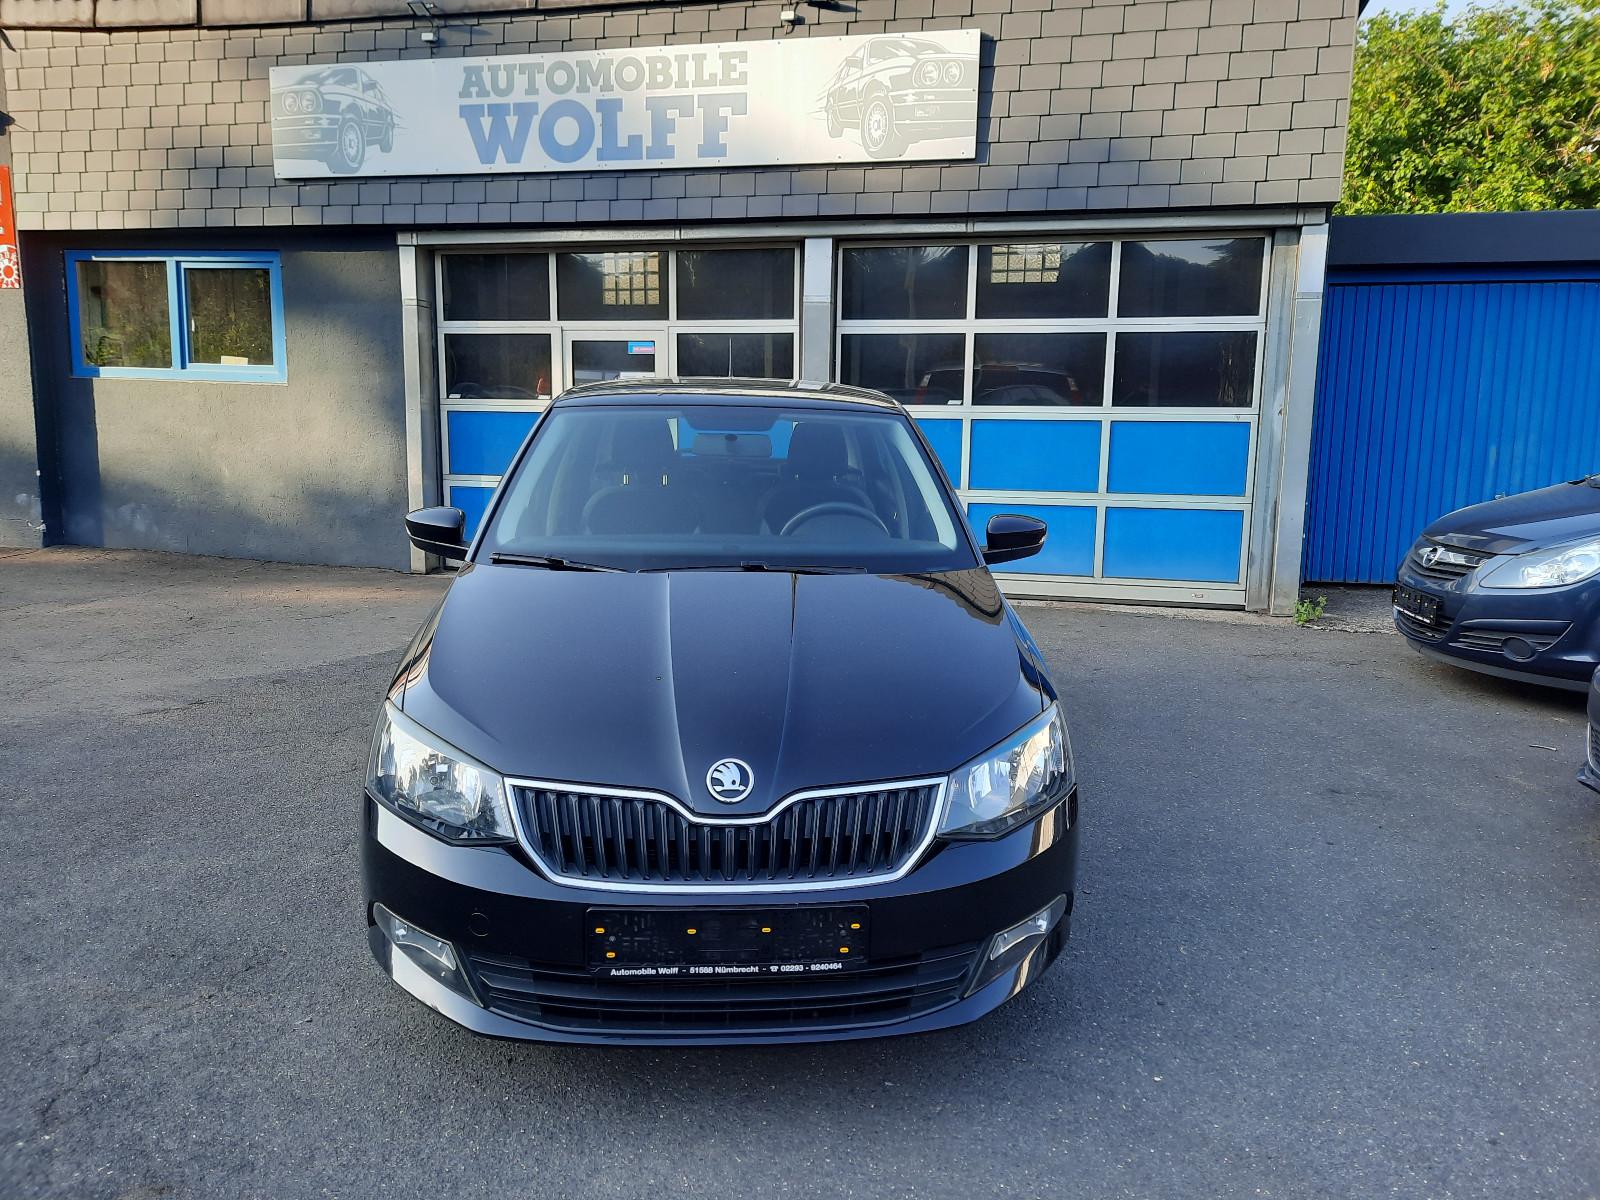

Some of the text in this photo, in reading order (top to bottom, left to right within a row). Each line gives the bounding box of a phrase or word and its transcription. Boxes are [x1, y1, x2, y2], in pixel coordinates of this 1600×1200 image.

[458, 50, 749, 98] AUTOMOBILE
[458, 92, 748, 165] WOLFF
[610, 967, 657, 976] Automobile
[657, 967, 679, 975] Wolff
[715, 965, 760, 974] Nümbrecht
[780, 964, 804, 972] 02293
